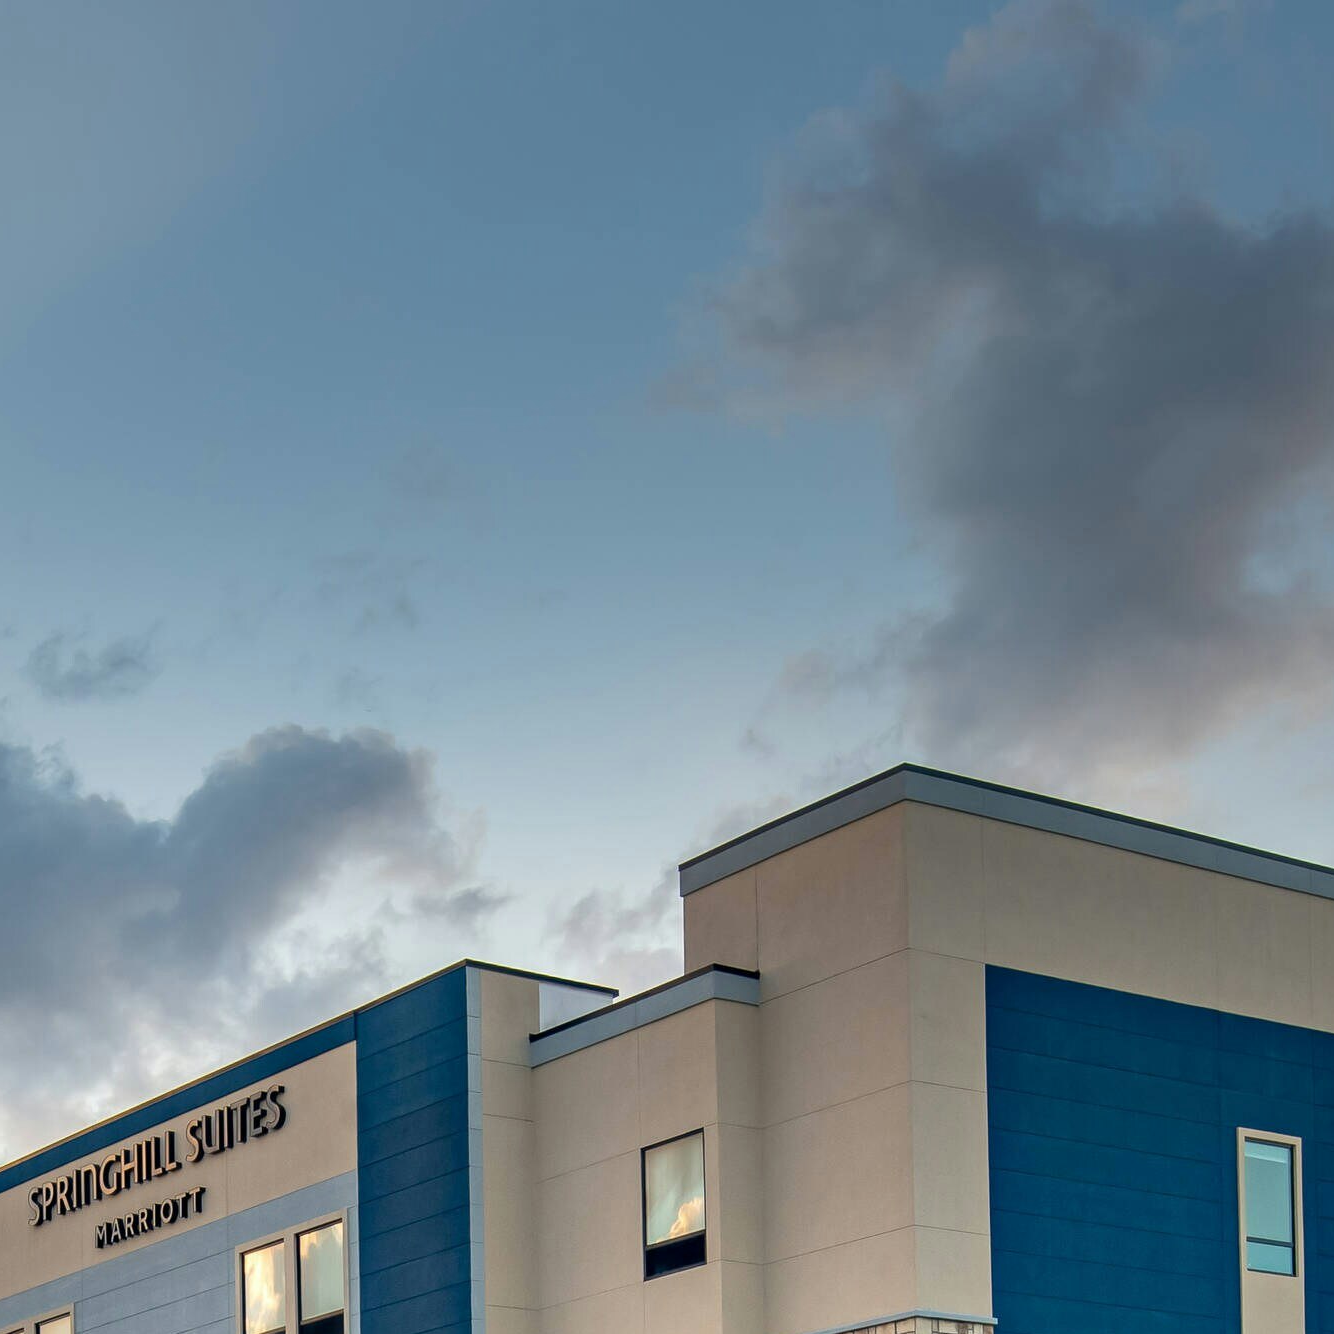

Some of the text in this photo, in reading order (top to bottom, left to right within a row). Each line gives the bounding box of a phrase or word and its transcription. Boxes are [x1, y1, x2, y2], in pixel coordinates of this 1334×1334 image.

[28, 1084, 286, 1226] SPRINGHILL SUITES
[94, 1186, 206, 1249] MARRIOTT
